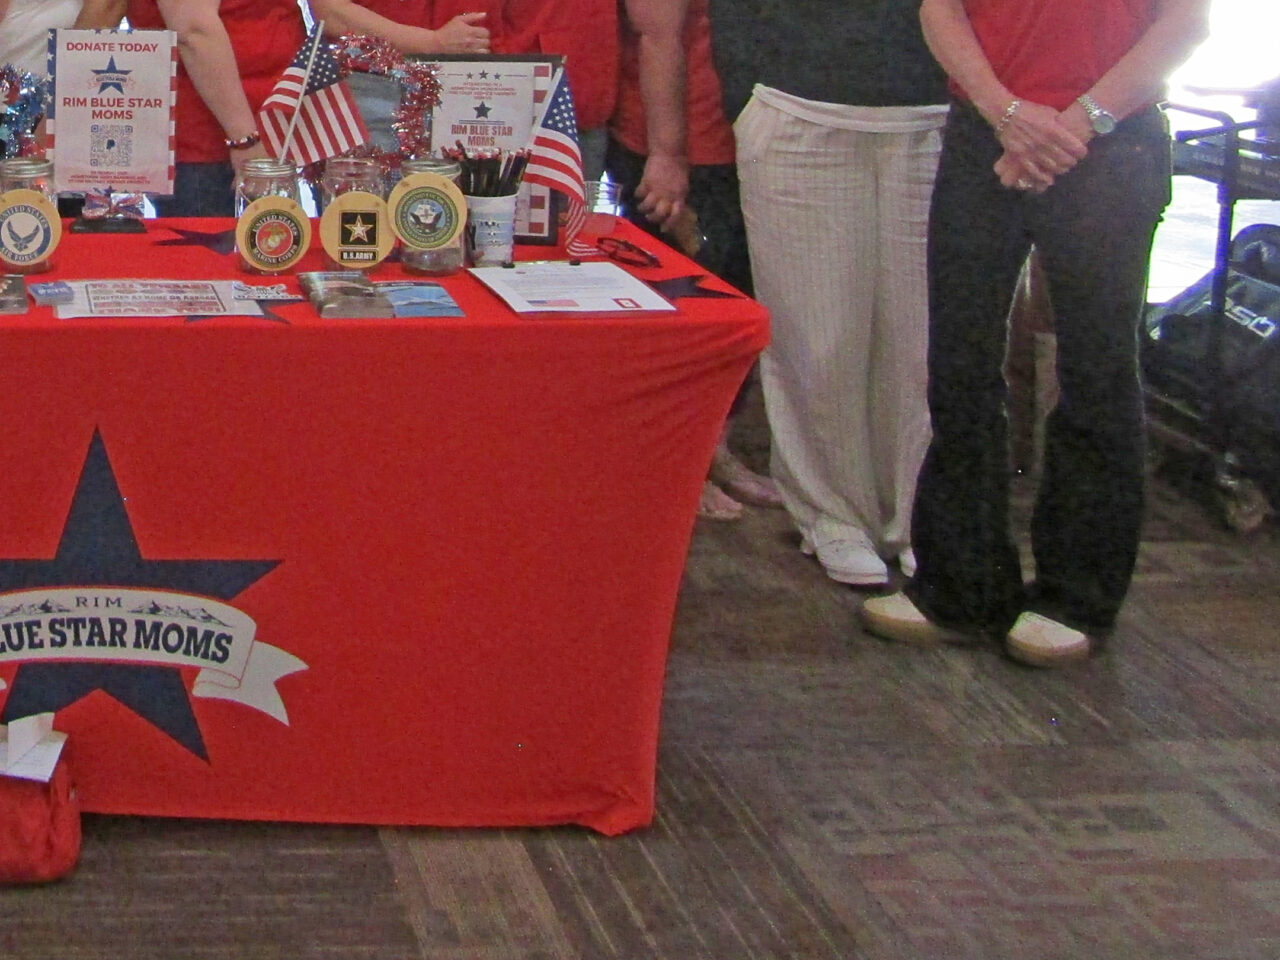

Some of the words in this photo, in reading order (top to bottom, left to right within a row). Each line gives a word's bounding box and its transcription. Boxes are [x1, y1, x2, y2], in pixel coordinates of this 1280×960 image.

[66, 42, 115, 52] DONATE
[117, 43, 159, 53] TODAY
[62, 97, 87, 107] RIM
[90, 97, 125, 108] BLUE
[127, 98, 163, 108] STAR
[91, 110, 133, 120] MOMS
[451, 124, 467, 136] RIM
[470, 125, 490, 136] BLUE
[492, 126, 512, 137] STAR
[467, 136, 495, 146] MOMS
[74, 596, 123, 609] RIM
[49, 616, 129, 649] STAR
[133, 618, 233, 663] MOMS
